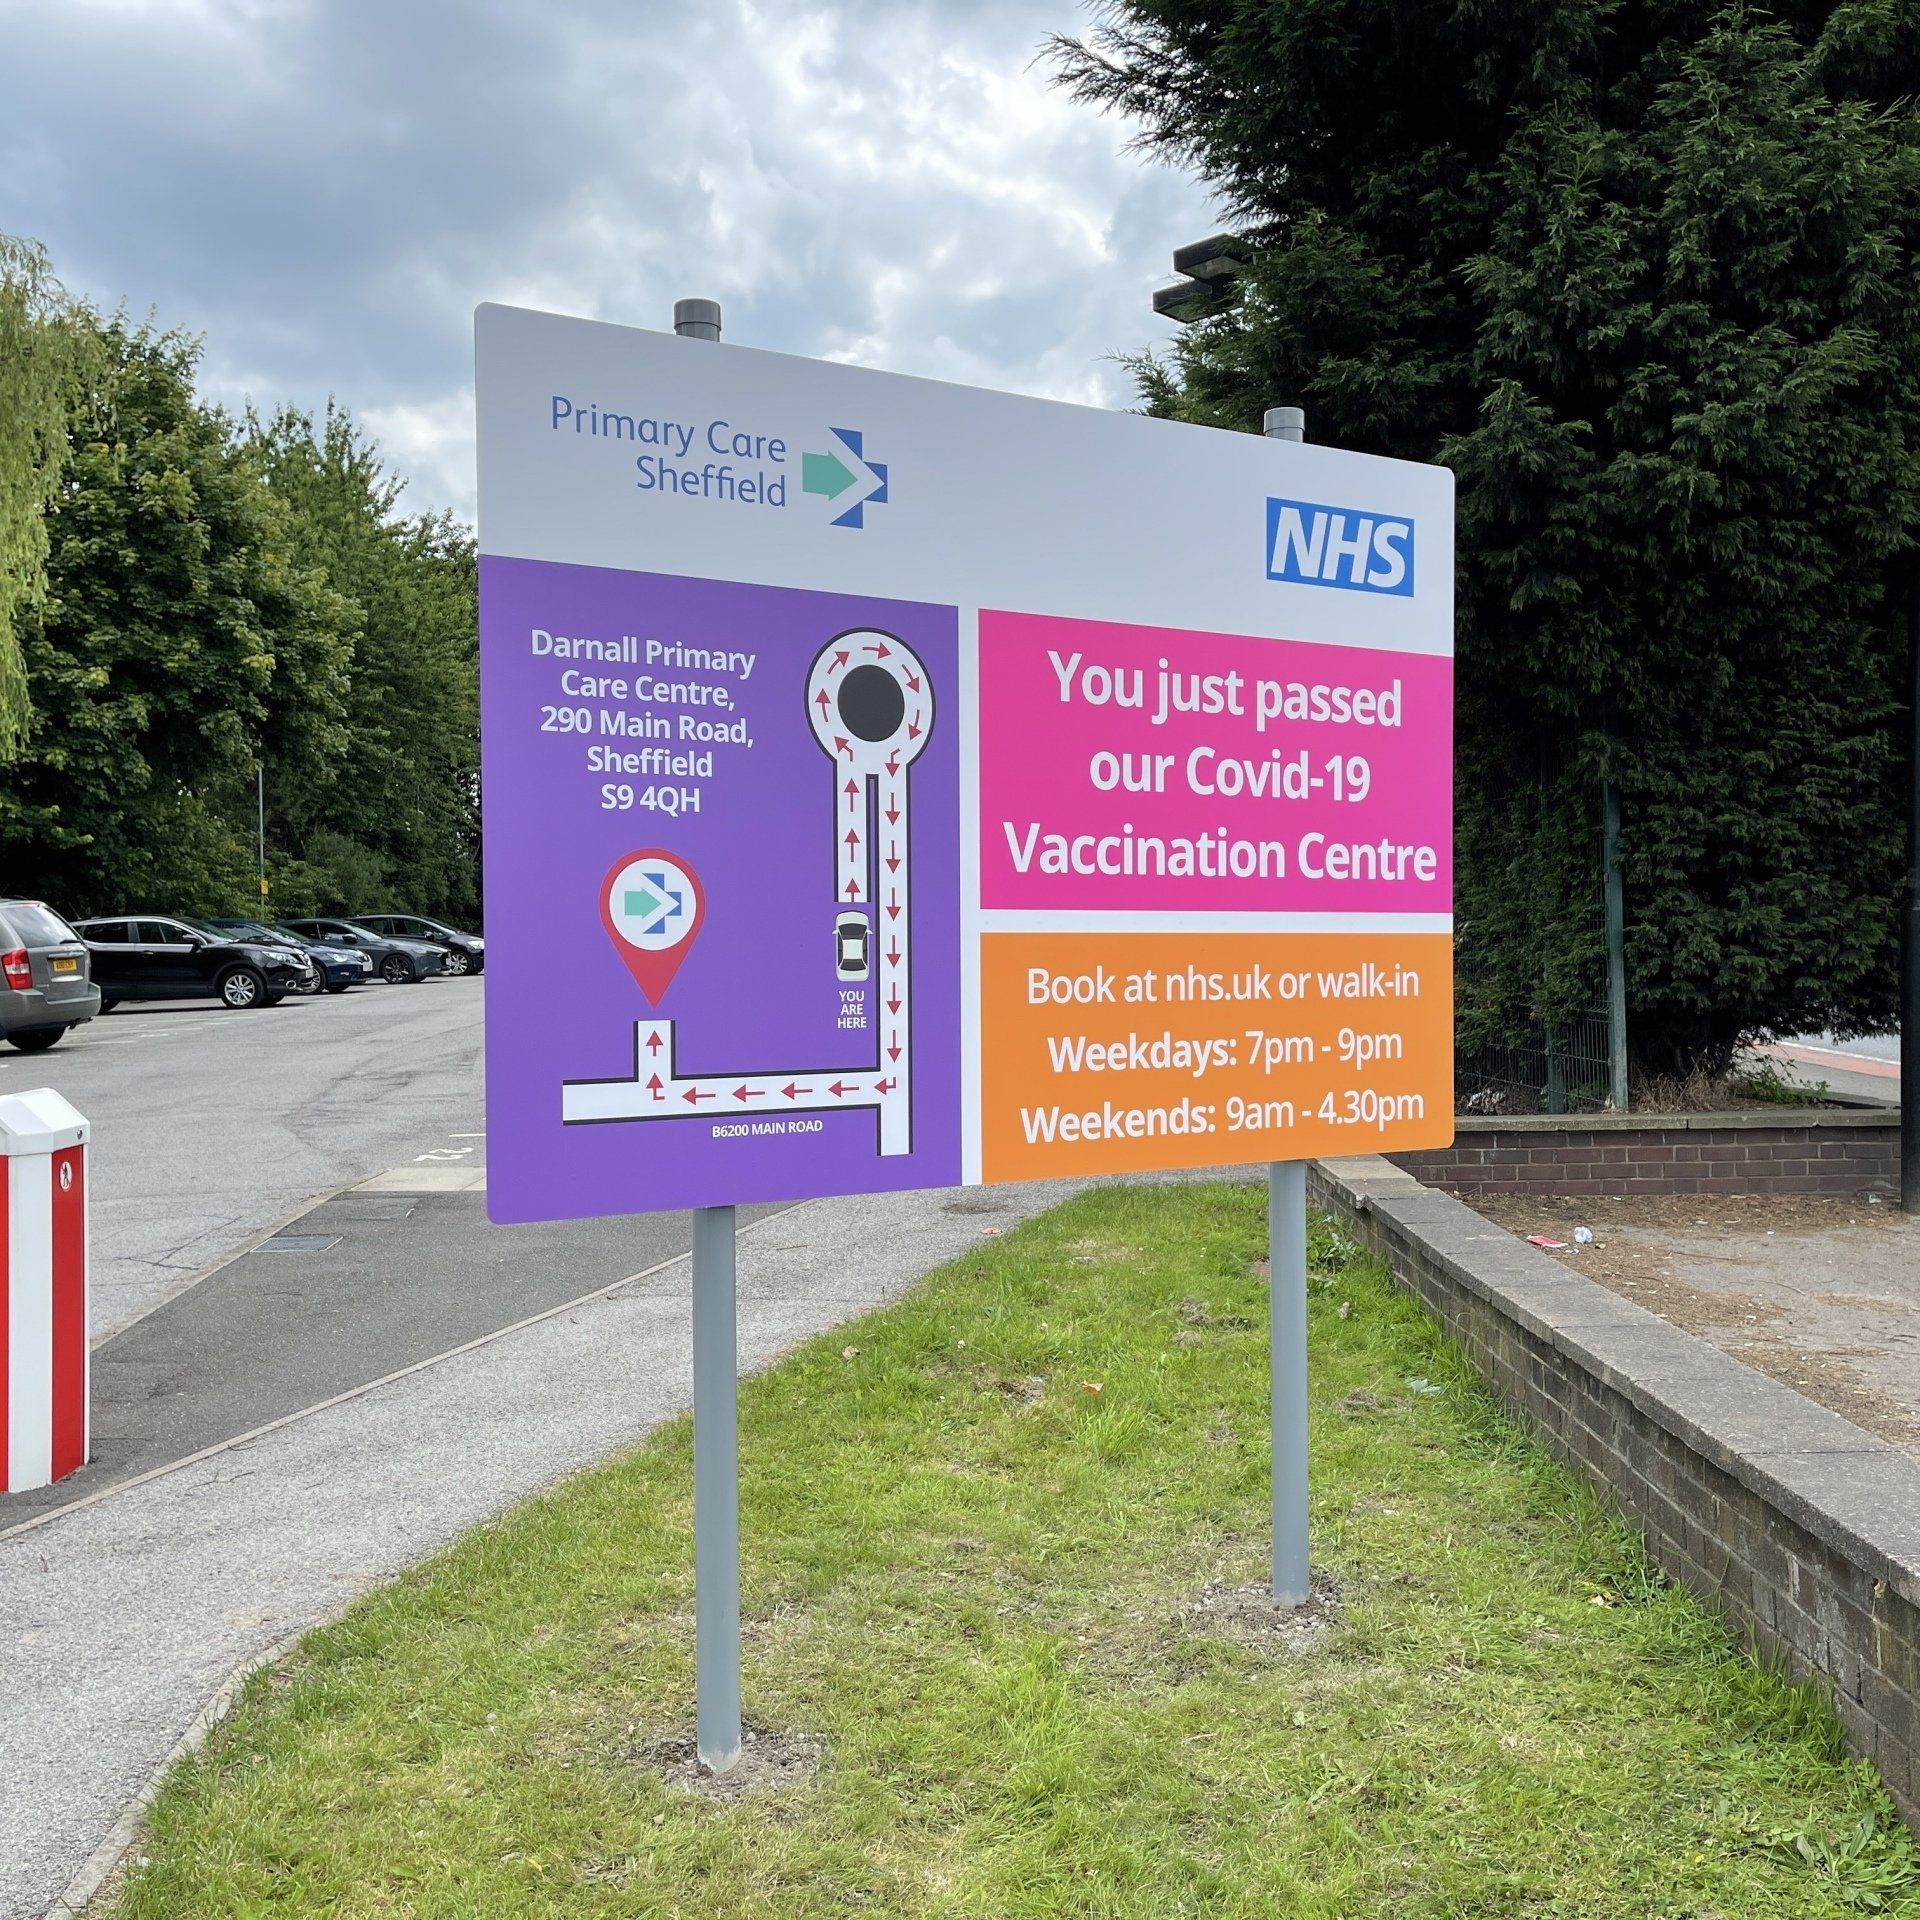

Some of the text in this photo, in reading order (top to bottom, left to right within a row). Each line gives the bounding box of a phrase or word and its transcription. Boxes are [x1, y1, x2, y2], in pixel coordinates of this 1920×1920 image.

[553, 396, 786, 462] Primary Care
[637, 456, 785, 507] Sheffield
[1270, 506, 1409, 588] NHS
[532, 630, 755, 678] Darnall Primary
[562, 670, 734, 711] Care Centre,
[1048, 651, 1401, 731] You just passed
[541, 706, 753, 747] 290 Main Road,
[588, 746, 712, 777] Sheffield
[1090, 747, 1370, 802] our Covid-19
[602, 784, 699, 817] S9 4QH
[1003, 822, 1436, 881] Vaccination Centre
[839, 991, 865, 1002] YOU
[1029, 963, 1418, 1003] Book at nhs.uk or walk-in
[837, 1017, 867, 1029] HERE
[840, 1004, 864, 1015] ARE
[1048, 1032, 1236, 1077] Weekdays:
[1246, 1031, 1313, 1074] 7pm
[1338, 1028, 1401, 1070] 9pm
[713, 1120, 822, 1137] B6200 MAIN ROAD
[1021, 1097, 1215, 1143] Weekends:
[1227, 1097, 1293, 1131] 9am
[1318, 1089, 1423, 1131] 4.30pm
